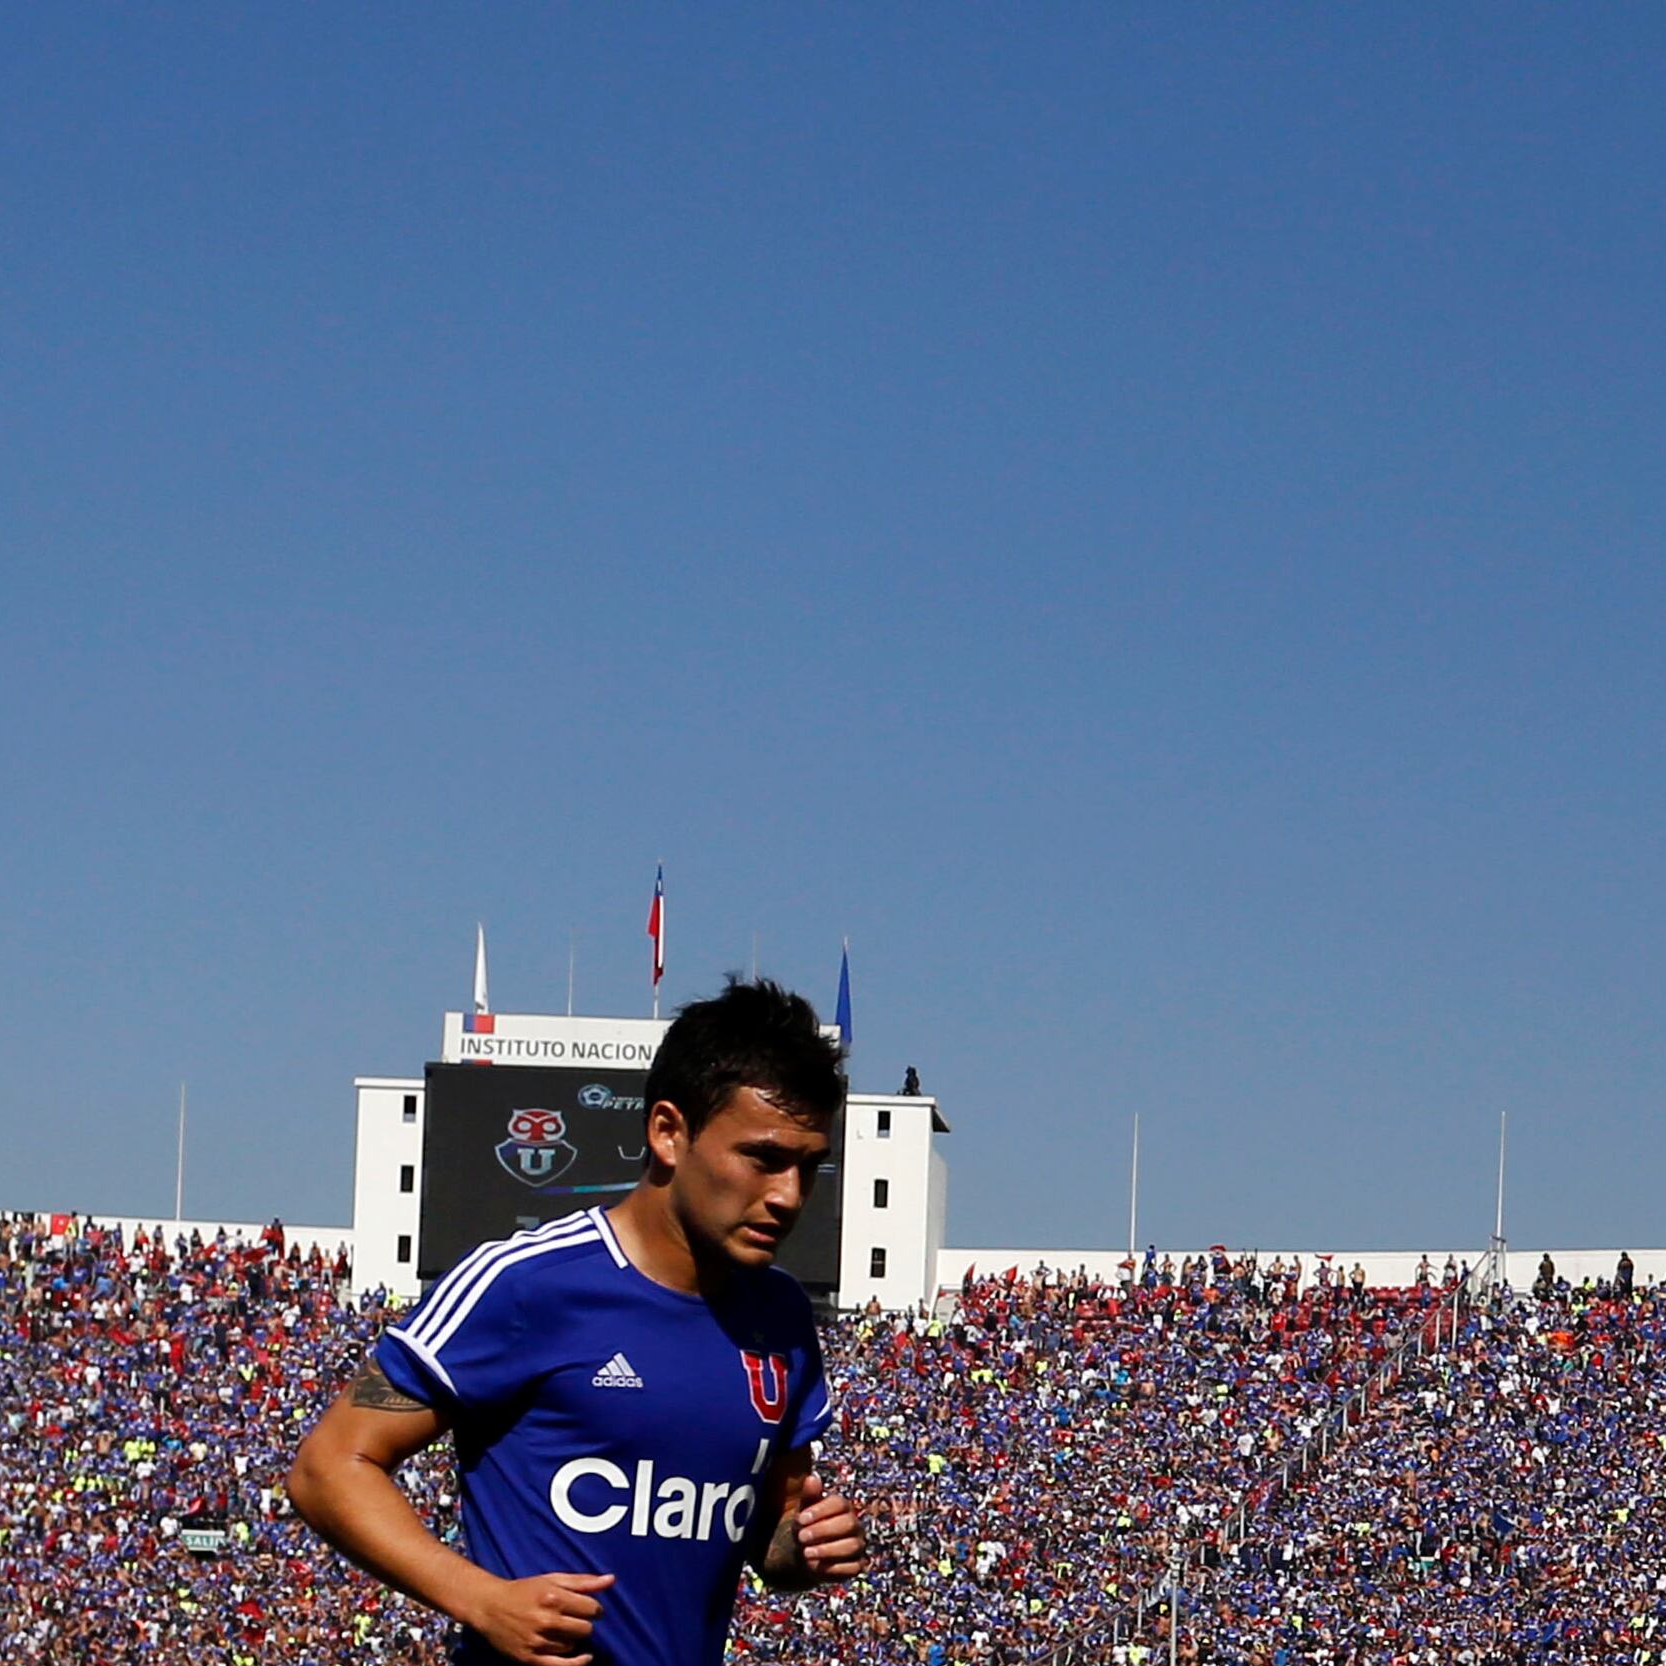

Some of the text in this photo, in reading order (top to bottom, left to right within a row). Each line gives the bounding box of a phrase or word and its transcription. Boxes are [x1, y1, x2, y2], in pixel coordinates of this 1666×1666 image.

[460, 1038, 565, 1057] INSTITUTO
[517, 1148, 556, 1175] U
[591, 1374, 644, 1388] adidas
[740, 1350, 789, 1424] U
[550, 1457, 756, 1543] Claro
